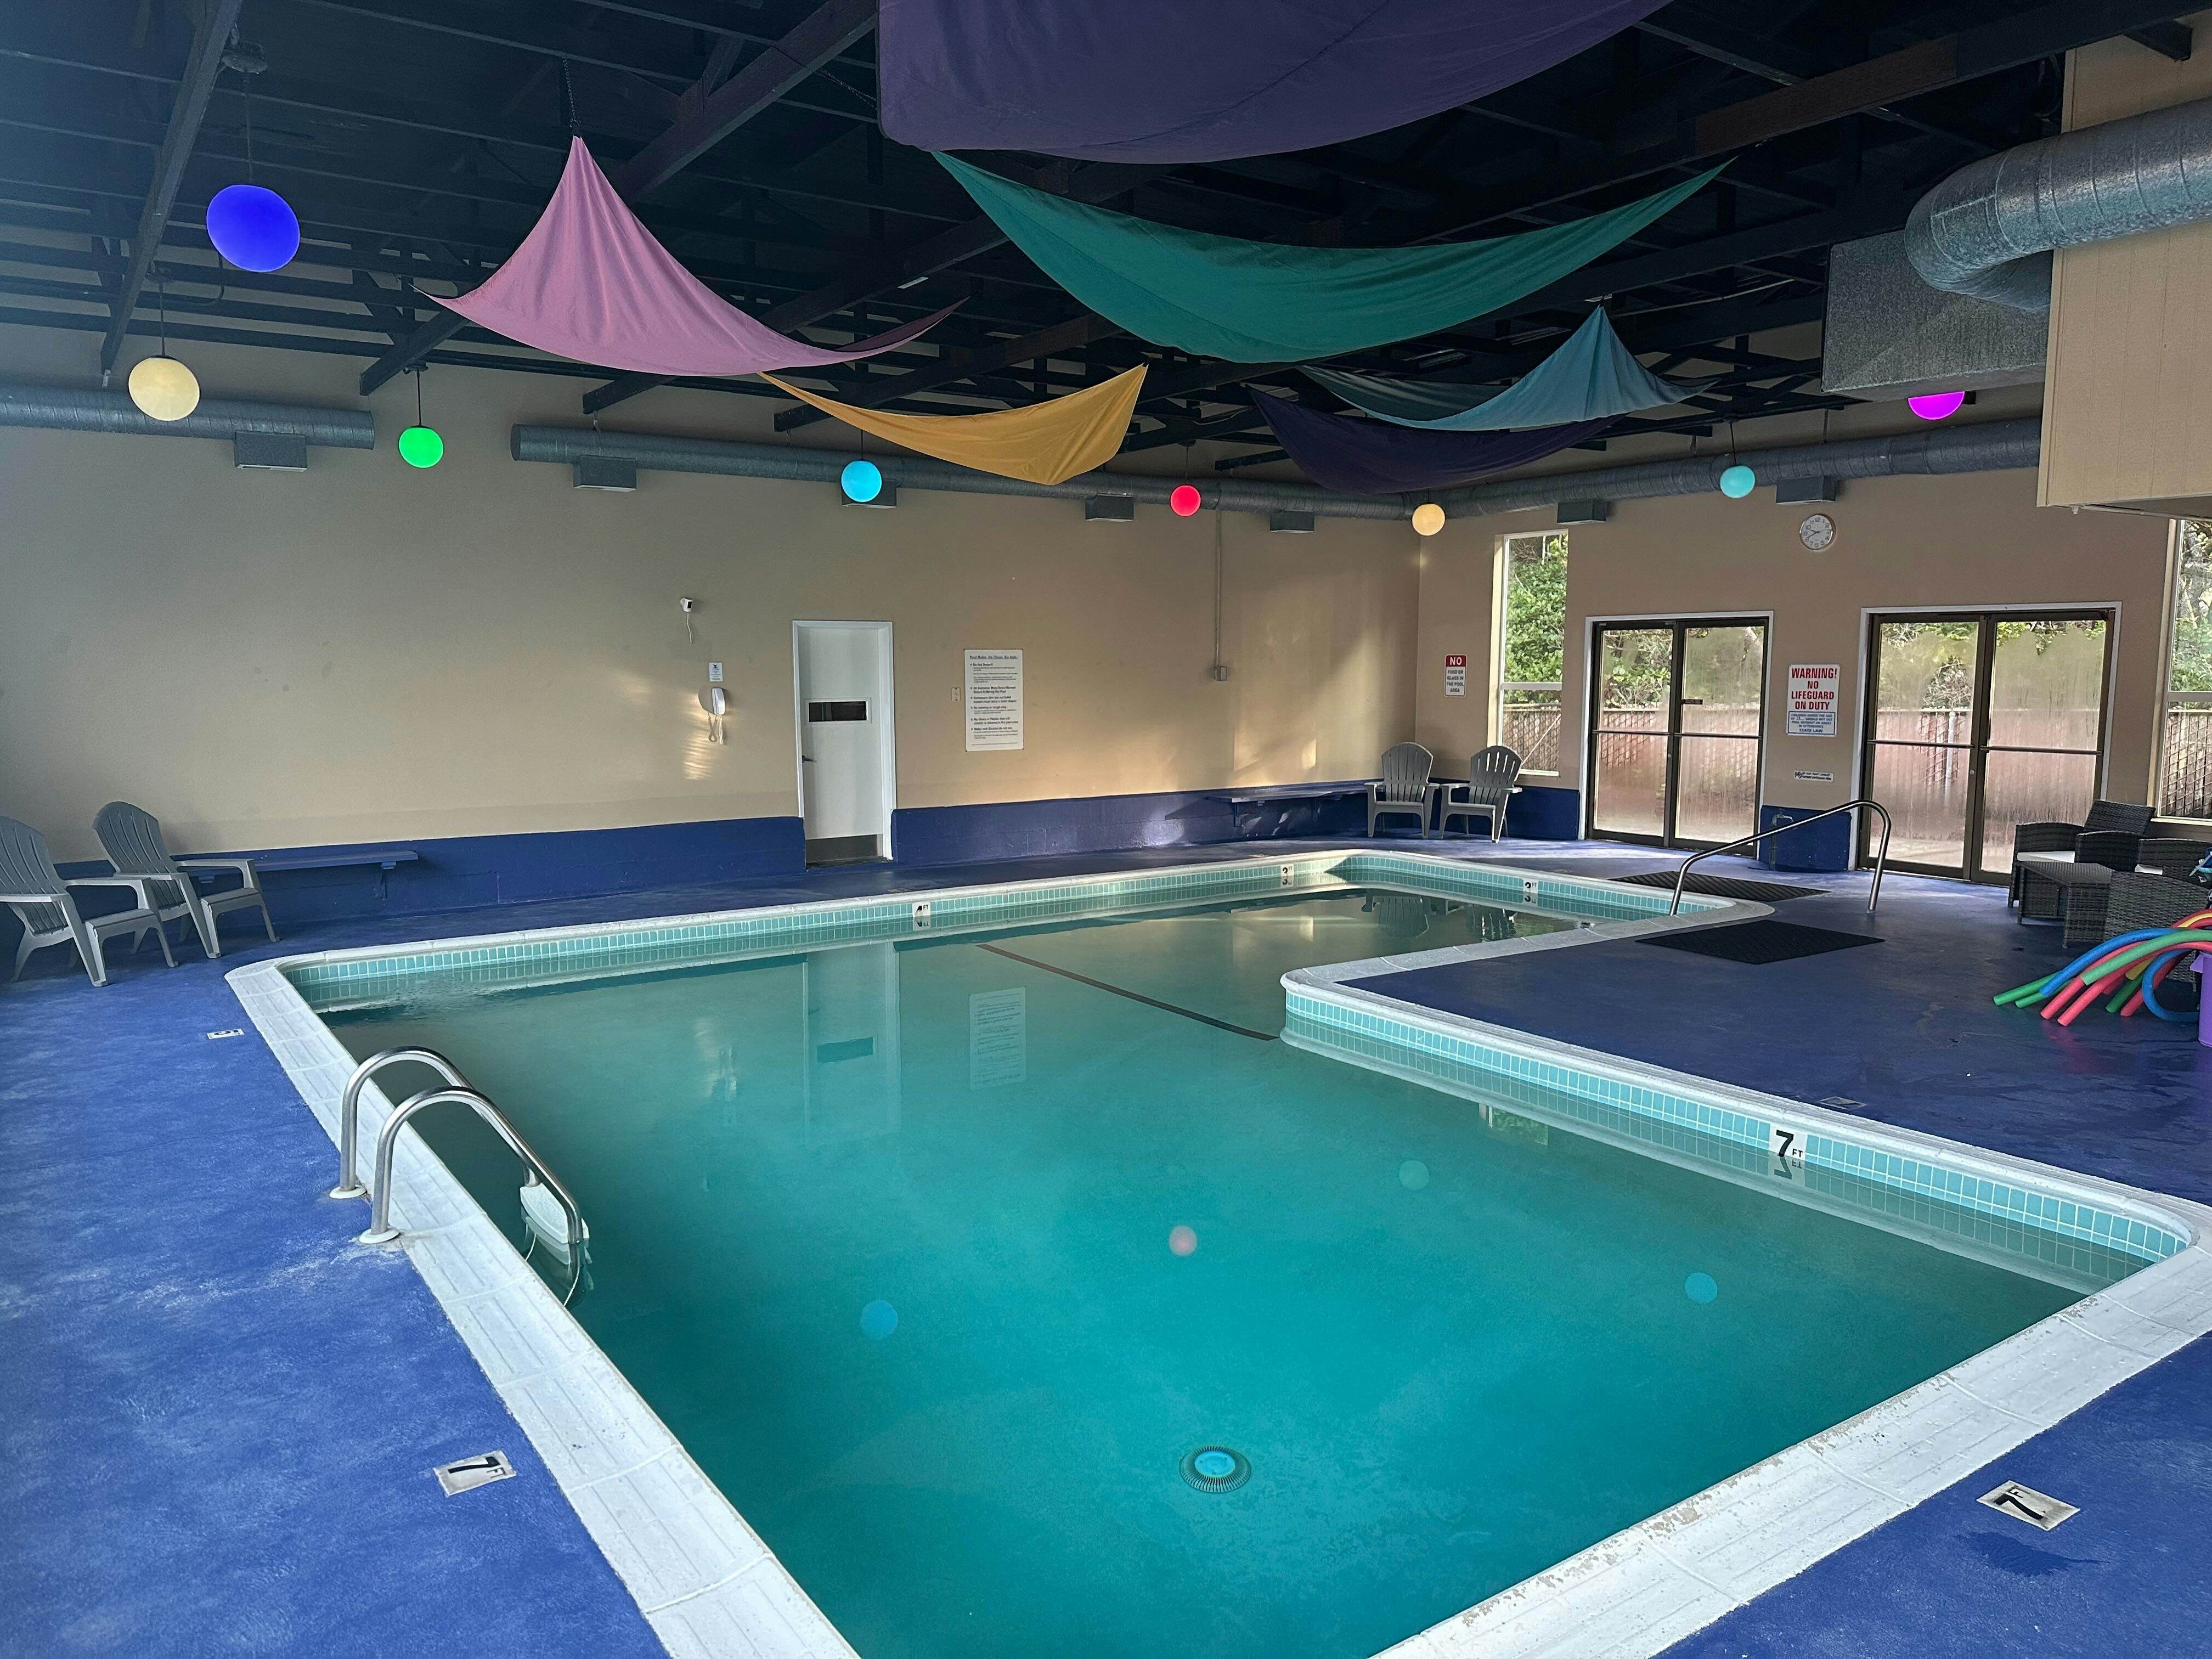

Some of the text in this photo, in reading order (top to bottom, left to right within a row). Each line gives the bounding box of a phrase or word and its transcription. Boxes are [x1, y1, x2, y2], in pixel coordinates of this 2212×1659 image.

[1450, 657, 1462, 665] NO
[1792, 668, 1837, 679] WARNING!
[1808, 681, 1819, 689] NO
[1791, 691, 1834, 699] LIFEGUARD
[1795, 701, 1830, 710] ON DUTY
[1776, 1130, 1803, 1158] 7 FT
[447, 1456, 508, 1479] 7 FT
[1994, 1493, 2044, 1520] 7
